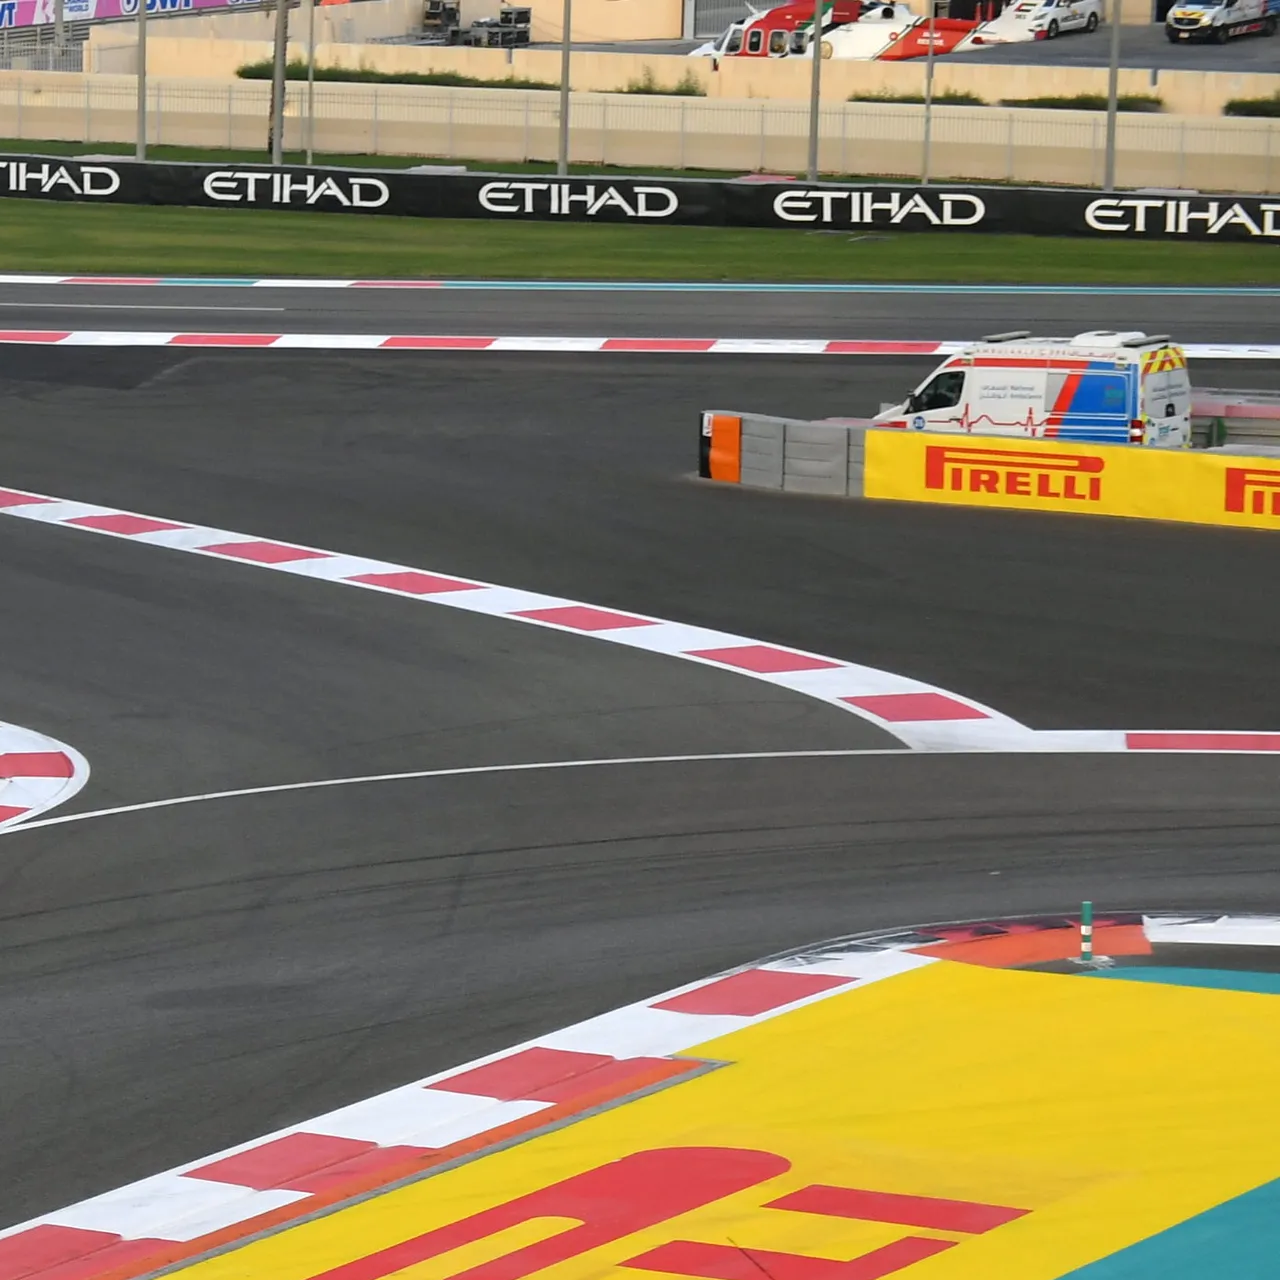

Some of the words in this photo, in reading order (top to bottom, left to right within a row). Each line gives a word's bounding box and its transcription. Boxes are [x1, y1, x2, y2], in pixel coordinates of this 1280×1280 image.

[203, 170, 389, 208] ETIHAD
[477, 181, 678, 217] ETIHAD
[773, 190, 986, 226] ETIHAD
[925, 445, 1105, 501] PIRELLI
